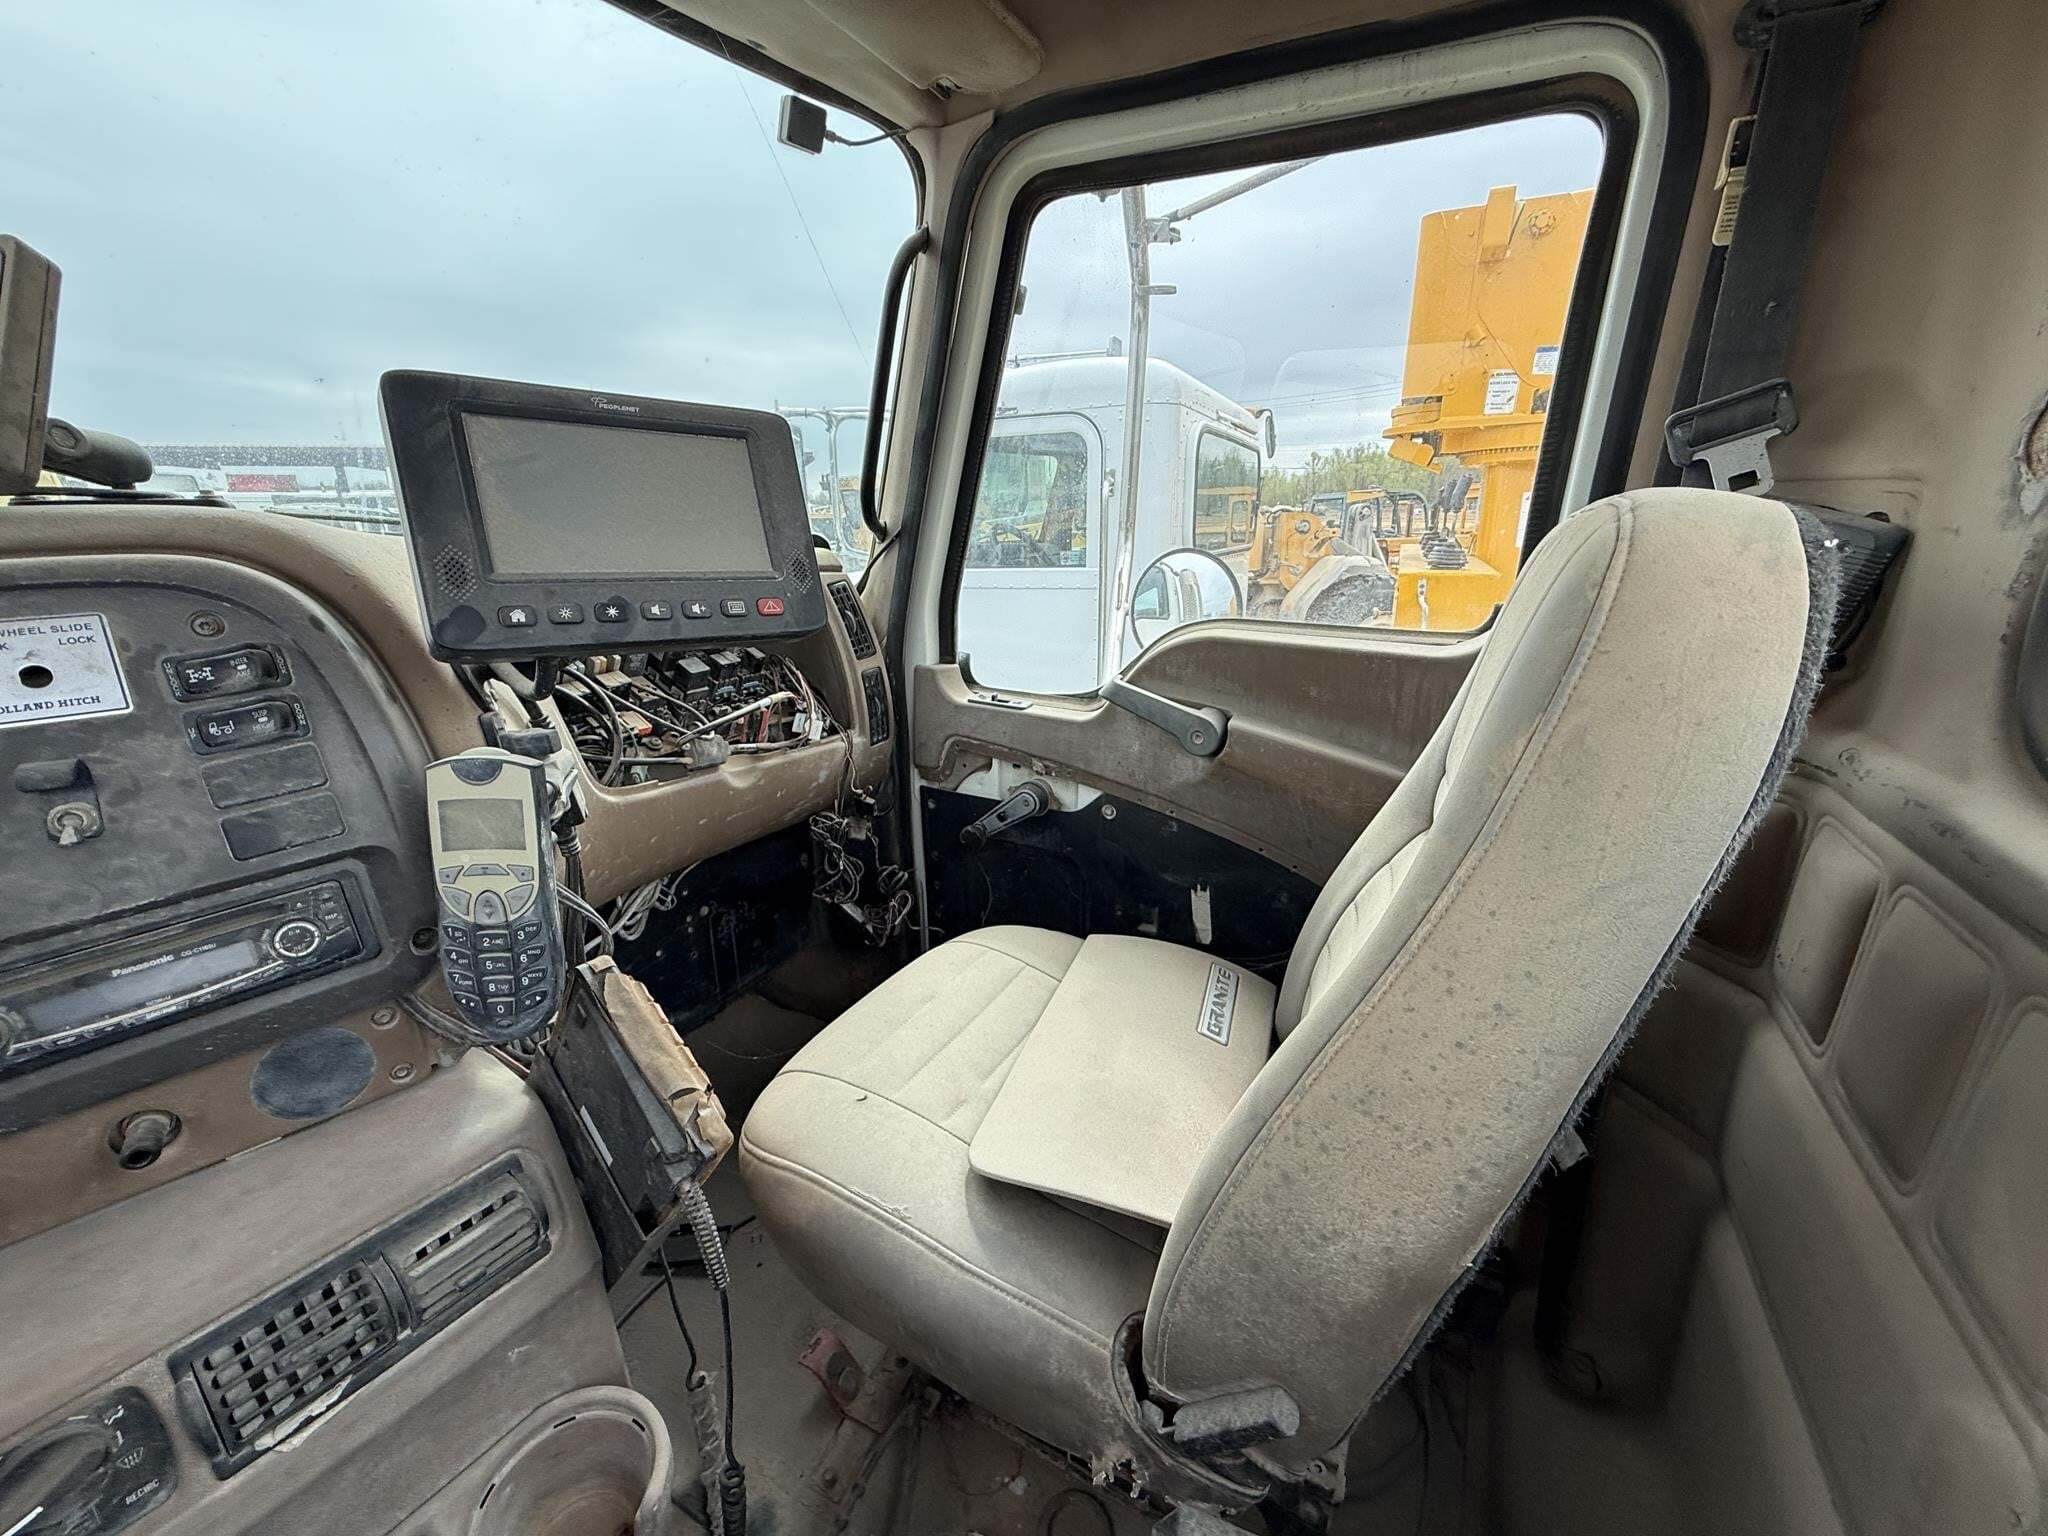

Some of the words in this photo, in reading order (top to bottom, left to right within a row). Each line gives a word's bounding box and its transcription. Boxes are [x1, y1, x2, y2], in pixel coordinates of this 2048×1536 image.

[50, 622, 94, 633] SLIDE
[58, 635, 97, 646] LOCK
[58, 695, 101, 708] HITCH
[447, 927, 453, 937] 1
[517, 930, 525, 940] 3
[482, 937, 490, 947] 2
[450, 951, 457, 960] 4
[520, 953, 528, 963] 6
[111, 953, 175, 978] Panasonic
[485, 960, 493, 970] 5
[452, 974, 460, 983] 7
[521, 976, 529, 986] 9
[488, 983, 496, 991] 8
[497, 1004, 505, 1014] 0
